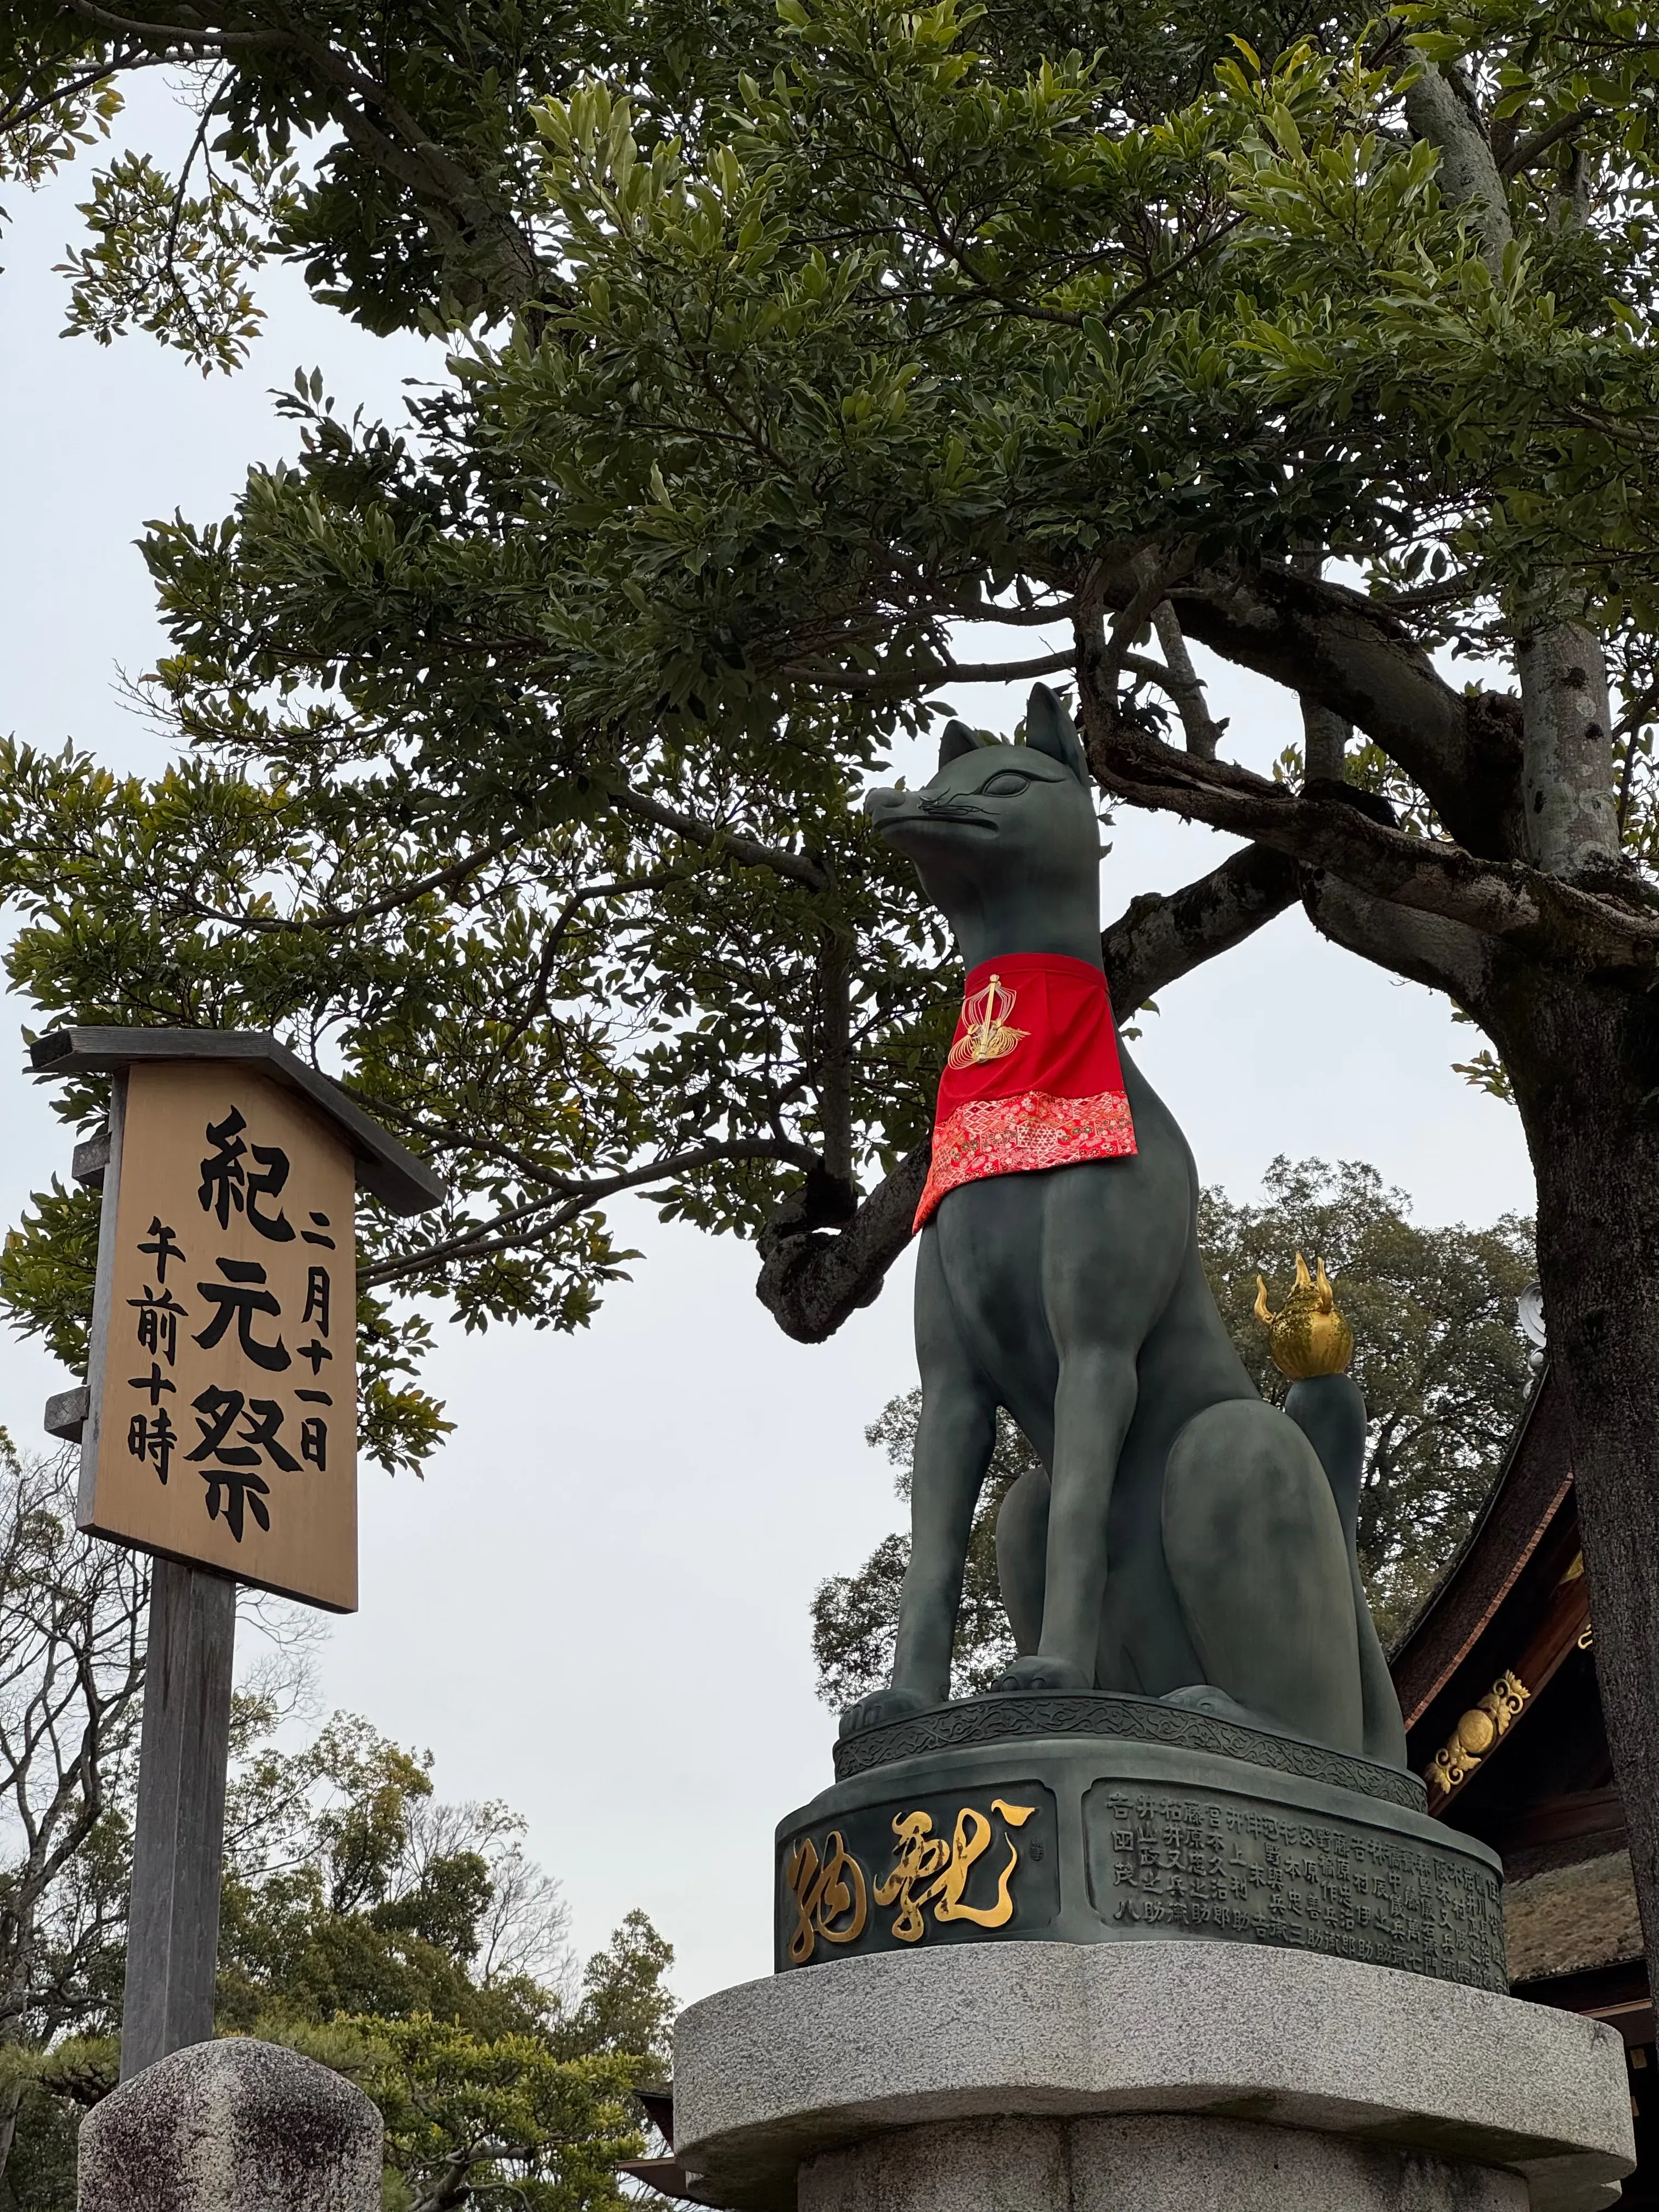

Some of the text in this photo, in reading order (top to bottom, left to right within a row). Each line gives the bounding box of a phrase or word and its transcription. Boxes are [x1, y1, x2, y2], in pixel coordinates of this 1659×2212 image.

[126, 1216, 189, 1486] 午前十時
[183, 1104, 303, 1543] 紀元祭
[295, 1212, 336, 1472] 二月十一日
